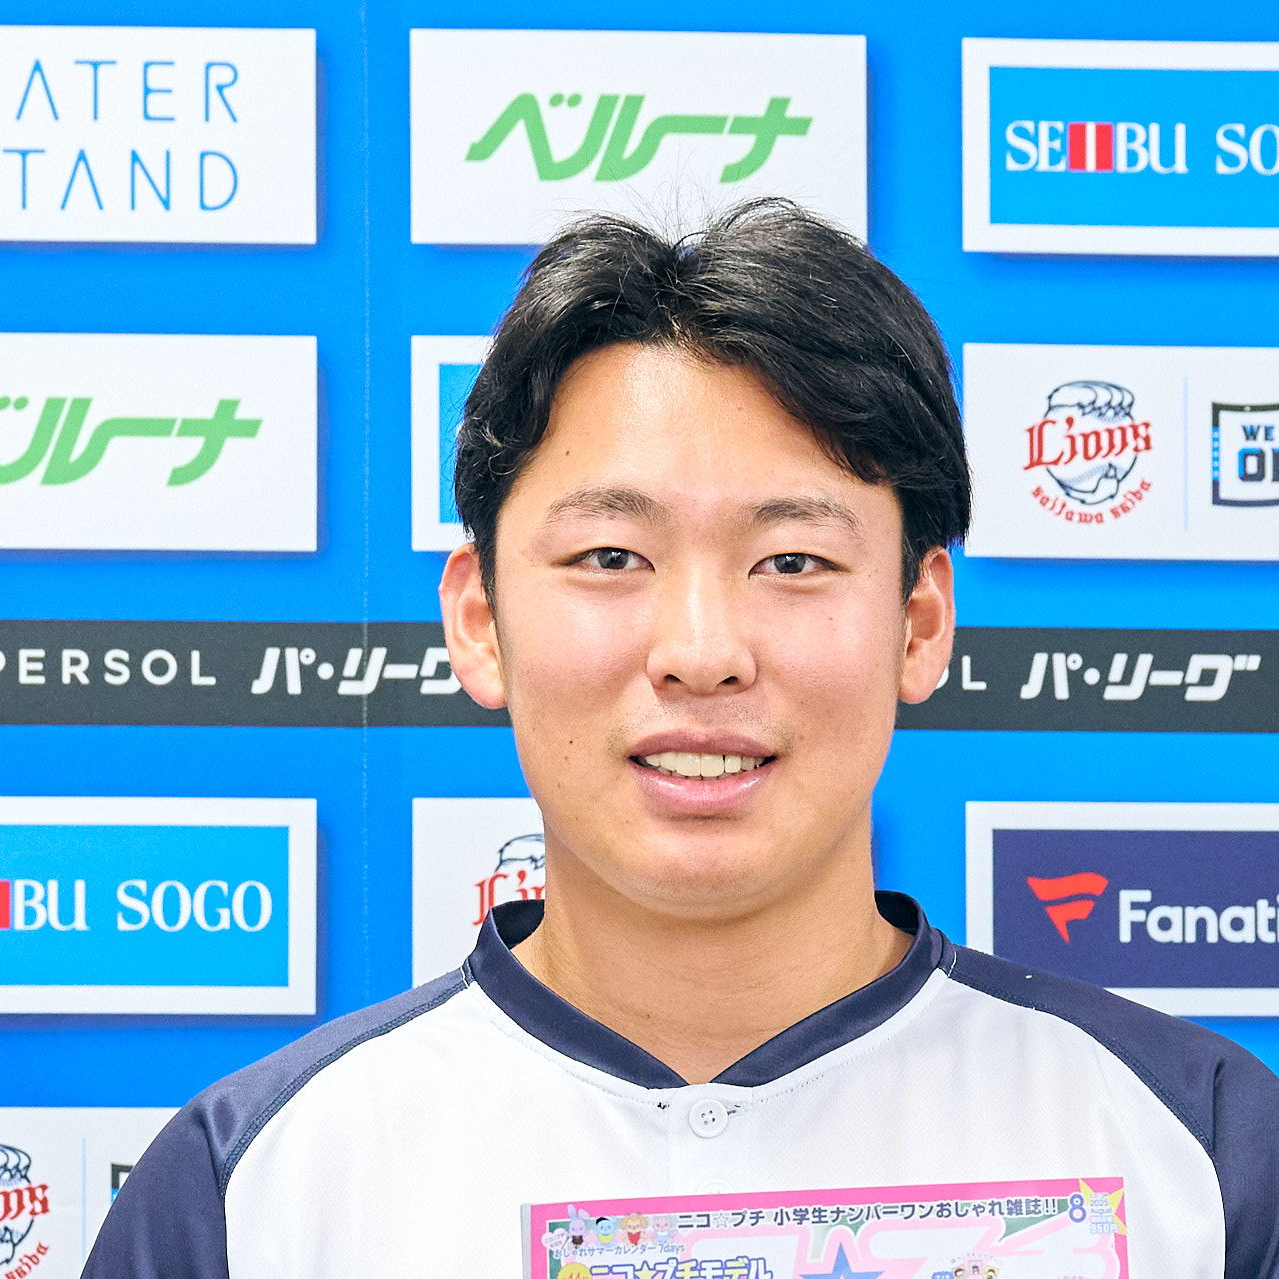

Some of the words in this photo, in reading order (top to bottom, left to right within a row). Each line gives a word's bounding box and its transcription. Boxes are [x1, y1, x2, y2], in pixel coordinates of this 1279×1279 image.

[1006, 121, 1188, 173] SEIBU
[1024, 417, 1151, 470] Lions
[1241, 425, 1273, 442] WE
[117, 880, 272, 932] SOGO
[1069, 1193, 1087, 1223] 8
